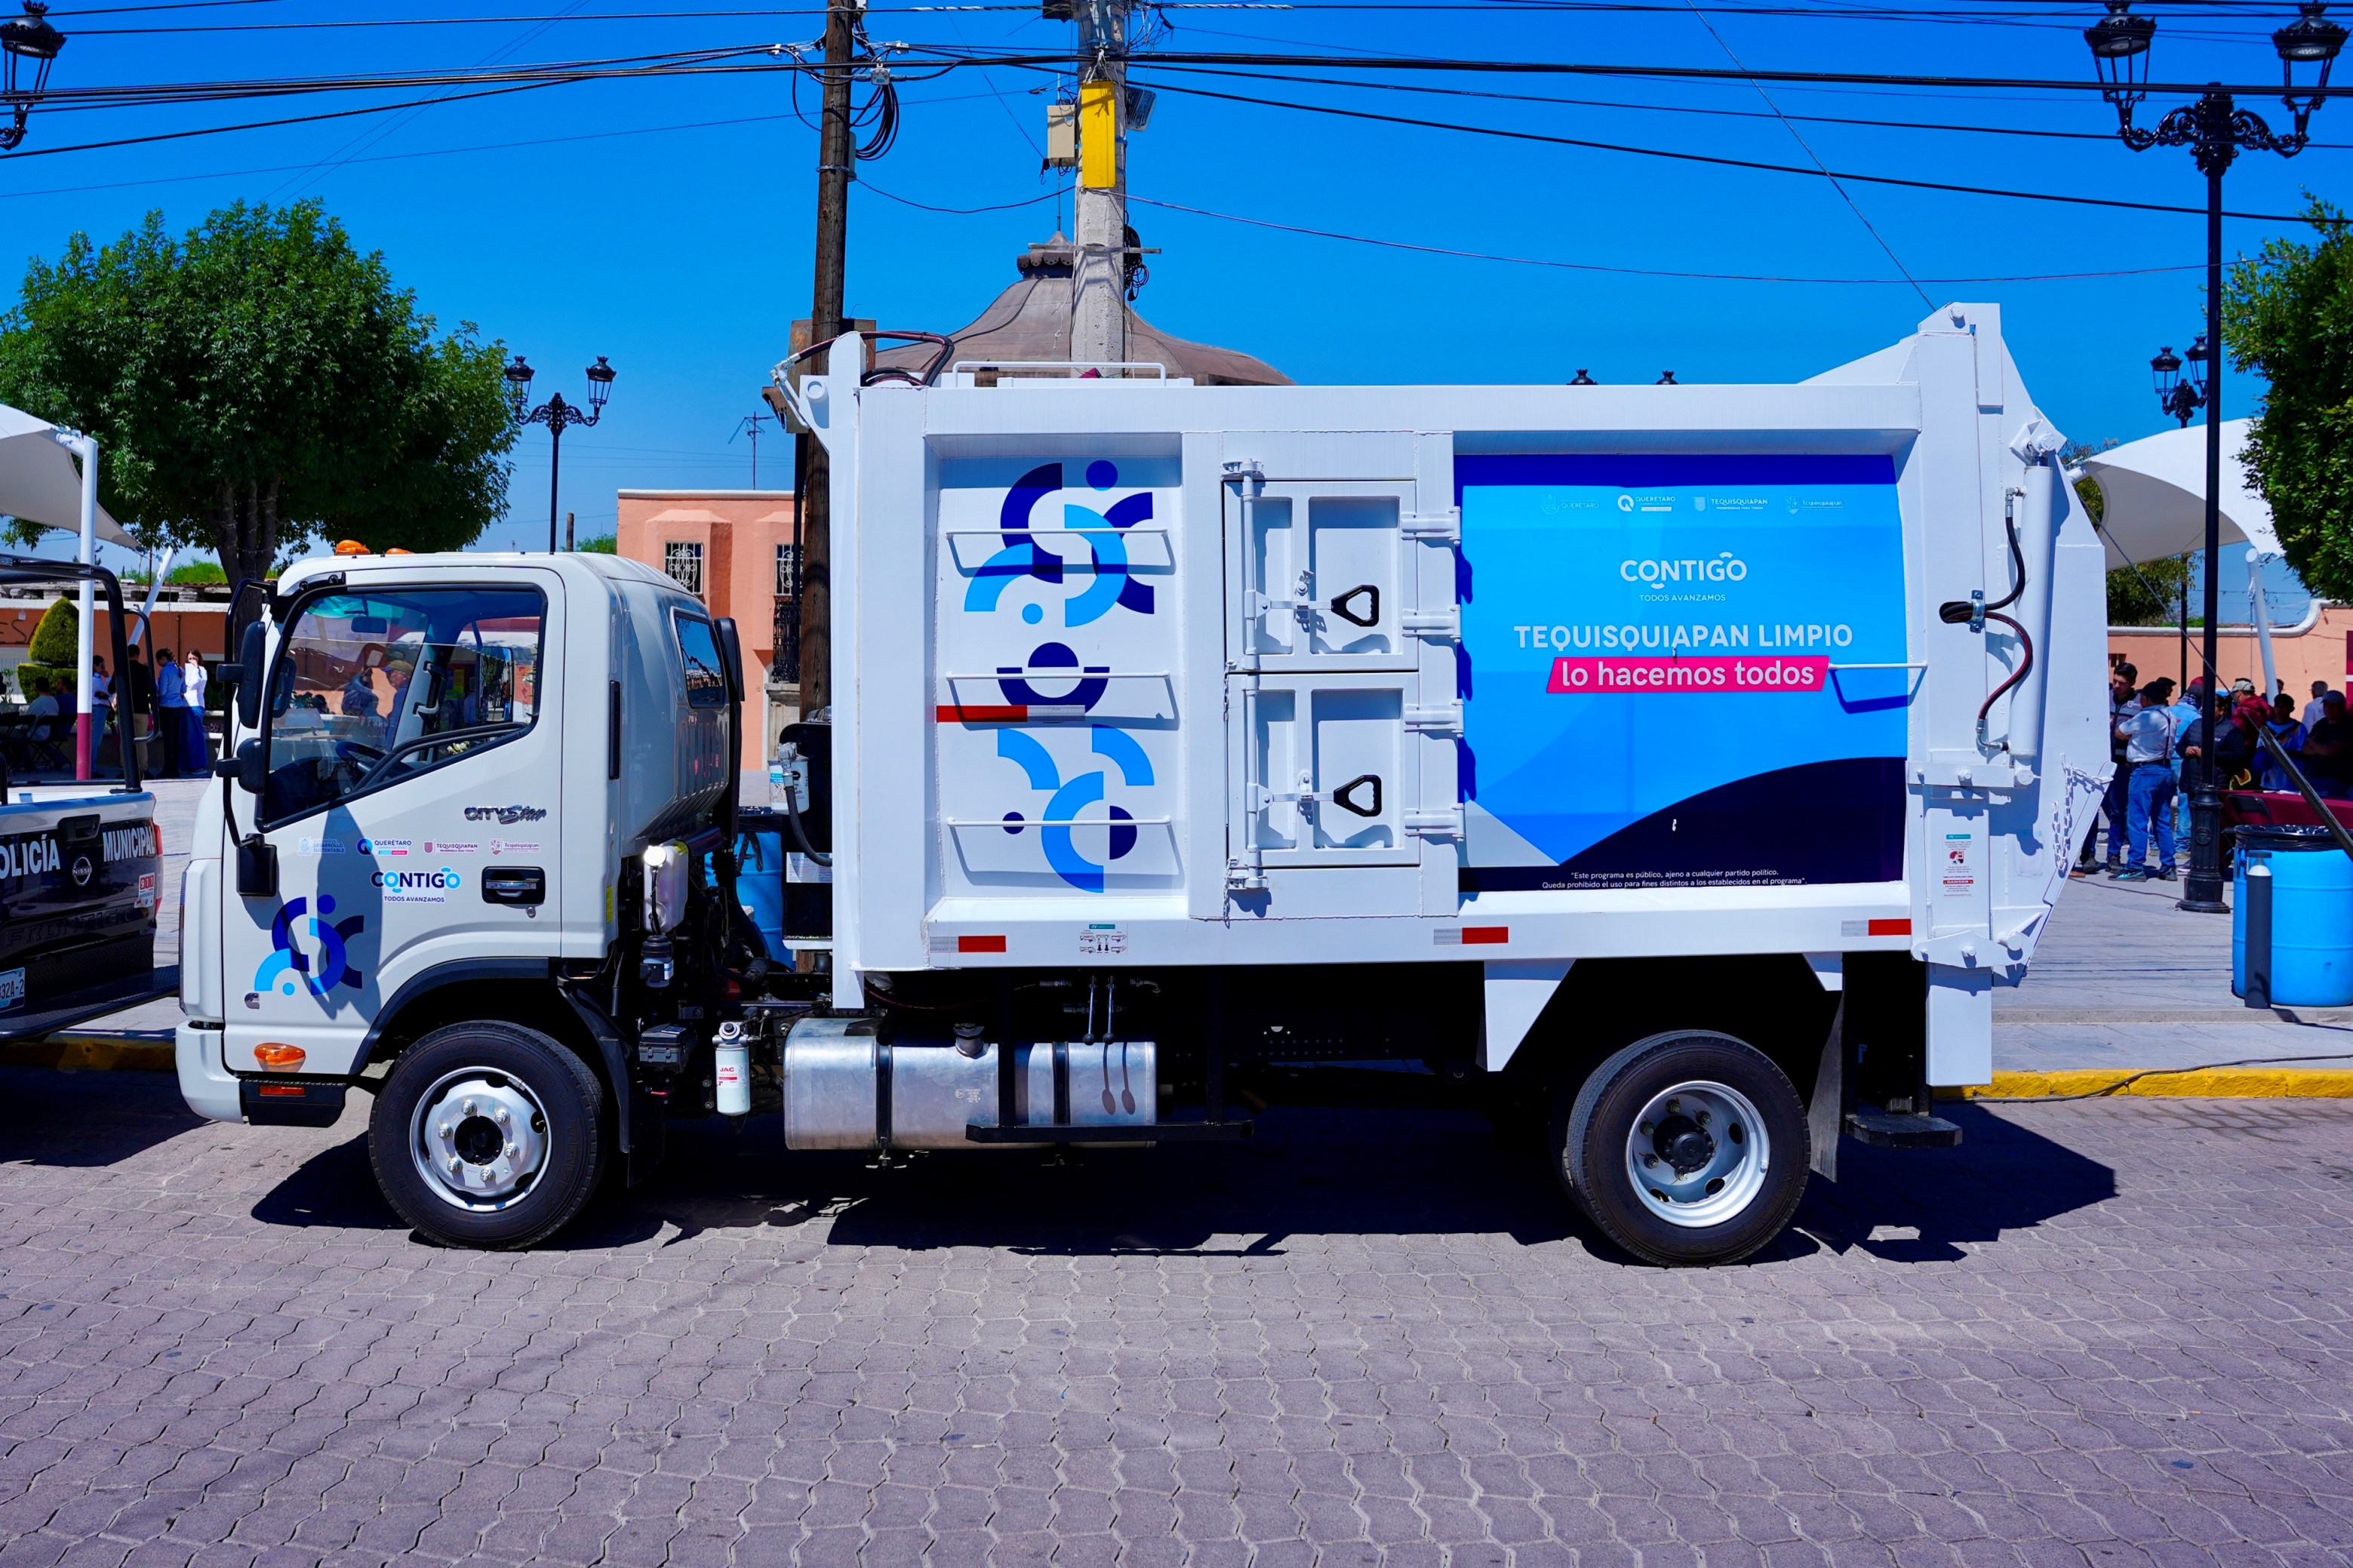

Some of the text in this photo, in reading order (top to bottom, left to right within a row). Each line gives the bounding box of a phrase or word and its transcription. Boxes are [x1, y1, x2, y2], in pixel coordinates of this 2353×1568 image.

[1620, 557, 1747, 583] CONTIGO
[1671, 593, 1727, 601] AVANZAMOS
[1514, 624, 1853, 652] TEQUISQUIAPAN LIMPIO
[1561, 660, 1814, 687] lo hacemos todos
[103, 826, 155, 862] MUNICIPAL
[141, 877, 153, 888] 911
[371, 869, 460, 890] CONTIGO
[1635, 871, 1663, 880] público,
[1665, 871, 1684, 879] ajeno
[1692, 869, 1724, 878] cualquier
[1725, 869, 1751, 878] partido
[1752, 869, 1779, 878] político.
[5, 905, 134, 947] FRONTIER
[0, 979, 24, 1000] 32A-2
